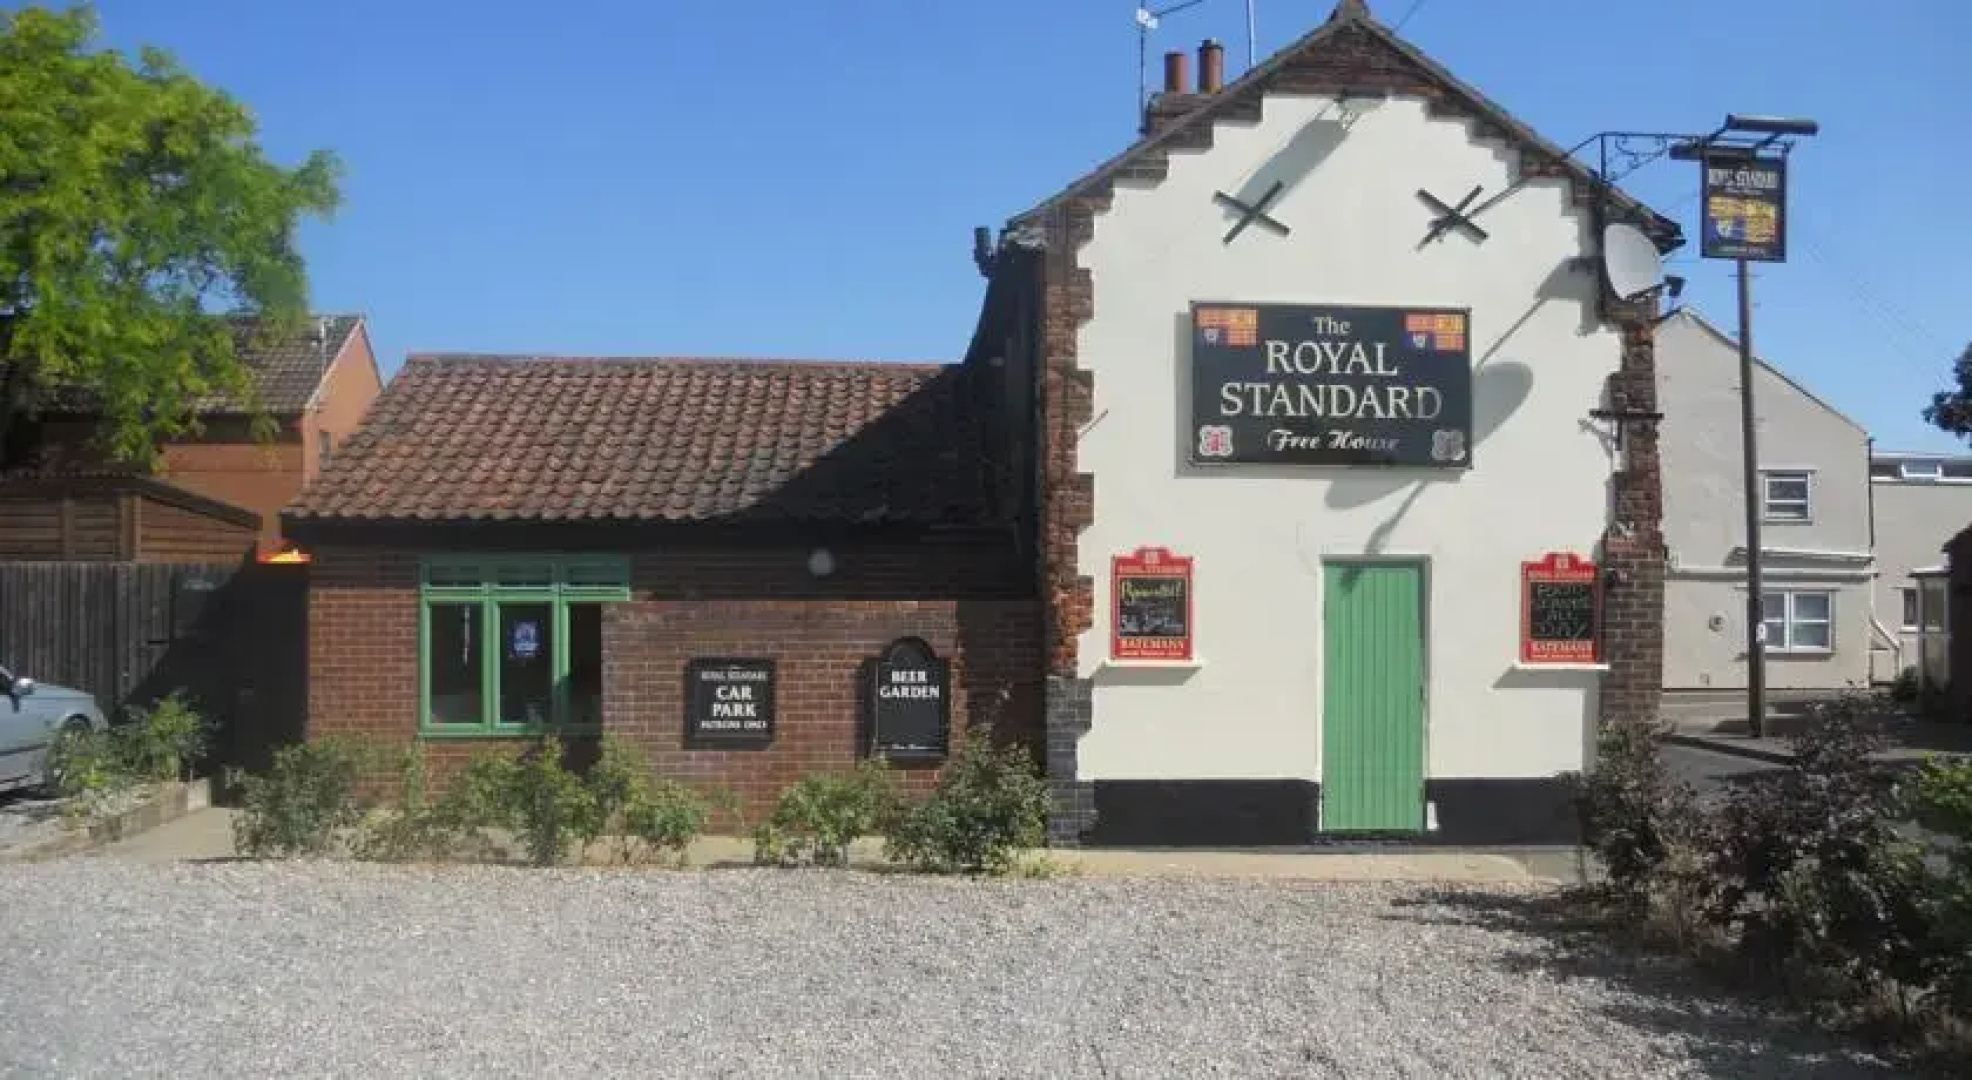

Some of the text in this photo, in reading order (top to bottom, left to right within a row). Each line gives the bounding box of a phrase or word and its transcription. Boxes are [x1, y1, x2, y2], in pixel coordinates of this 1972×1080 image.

[1313, 316, 1351, 335] The
[1265, 340, 1398, 376] ROYAL
[1220, 383, 1442, 419] STANDARD
[1267, 429, 1399, 451] Free House
[891, 670, 926, 683] BEER
[715, 685, 752, 700] CAR
[880, 685, 940, 698] GARDEN
[713, 702, 757, 717] PARK
